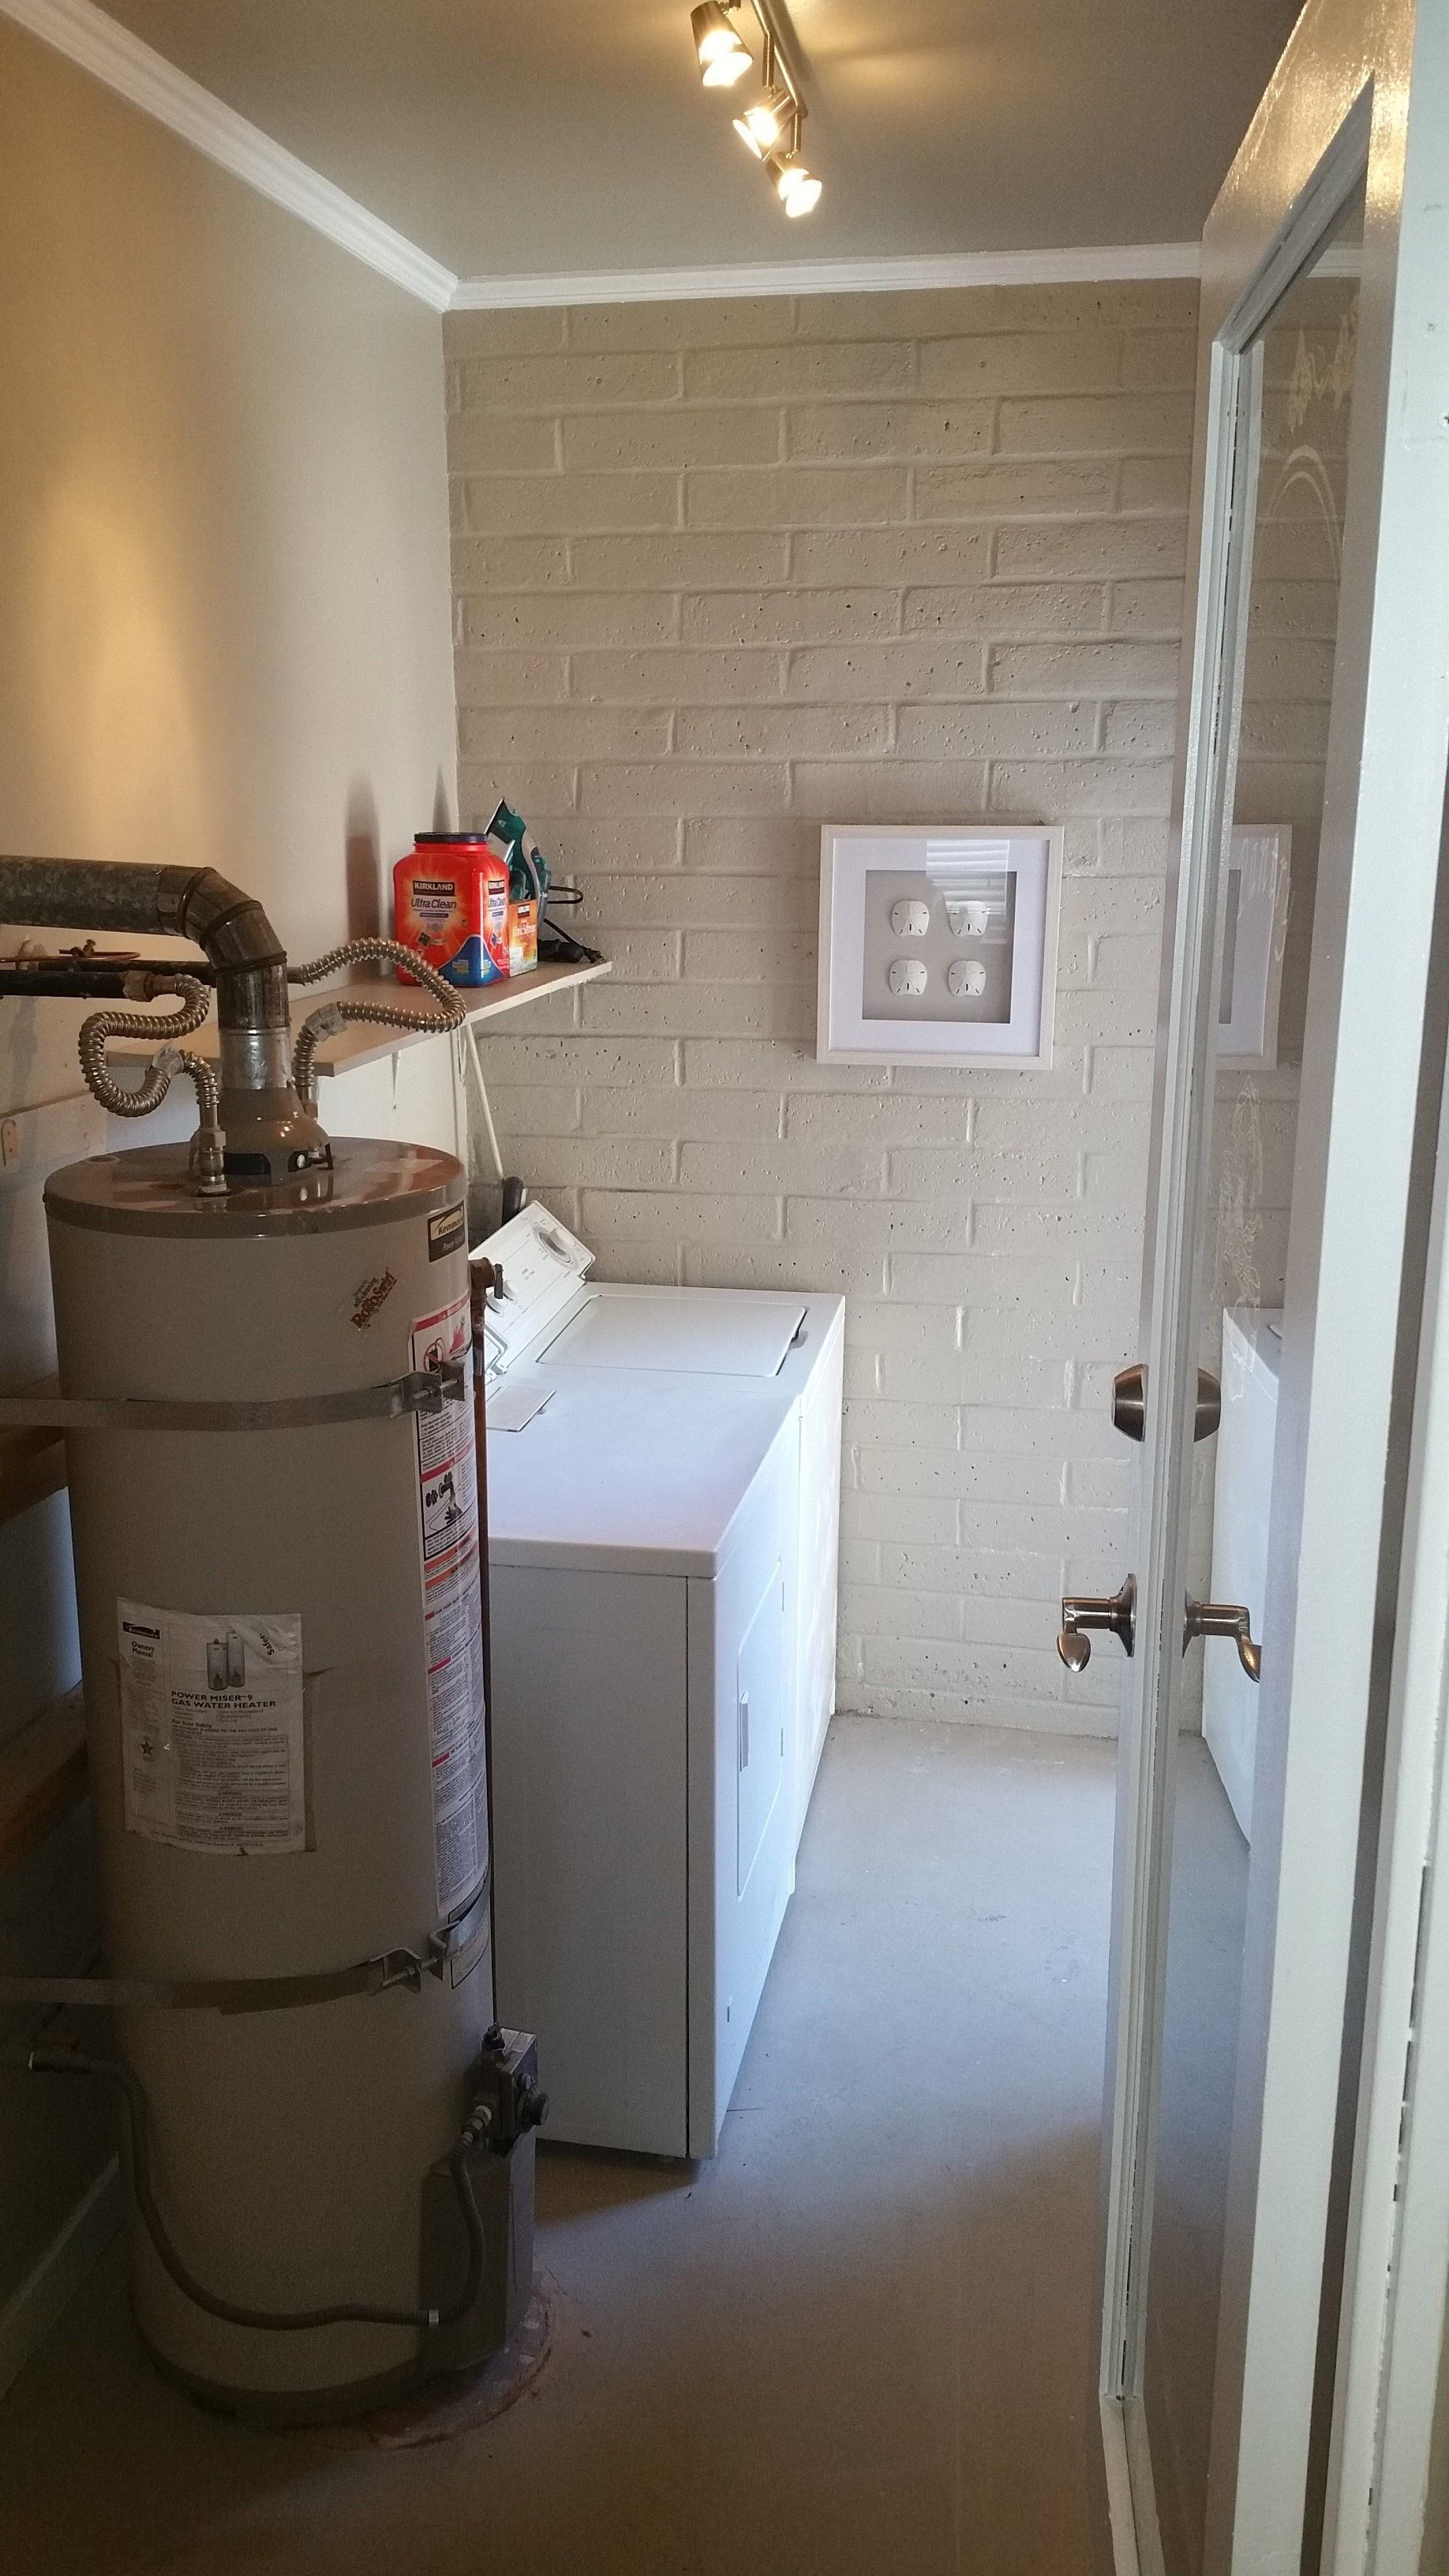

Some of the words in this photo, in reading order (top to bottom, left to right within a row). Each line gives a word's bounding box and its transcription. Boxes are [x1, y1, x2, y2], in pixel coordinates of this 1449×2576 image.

[414, 882, 453, 891] KIRKLAND
[132, 1647, 153, 1658] Manual
[171, 1690, 207, 1701] POWER
[234, 1700, 276, 1709] HEATER
